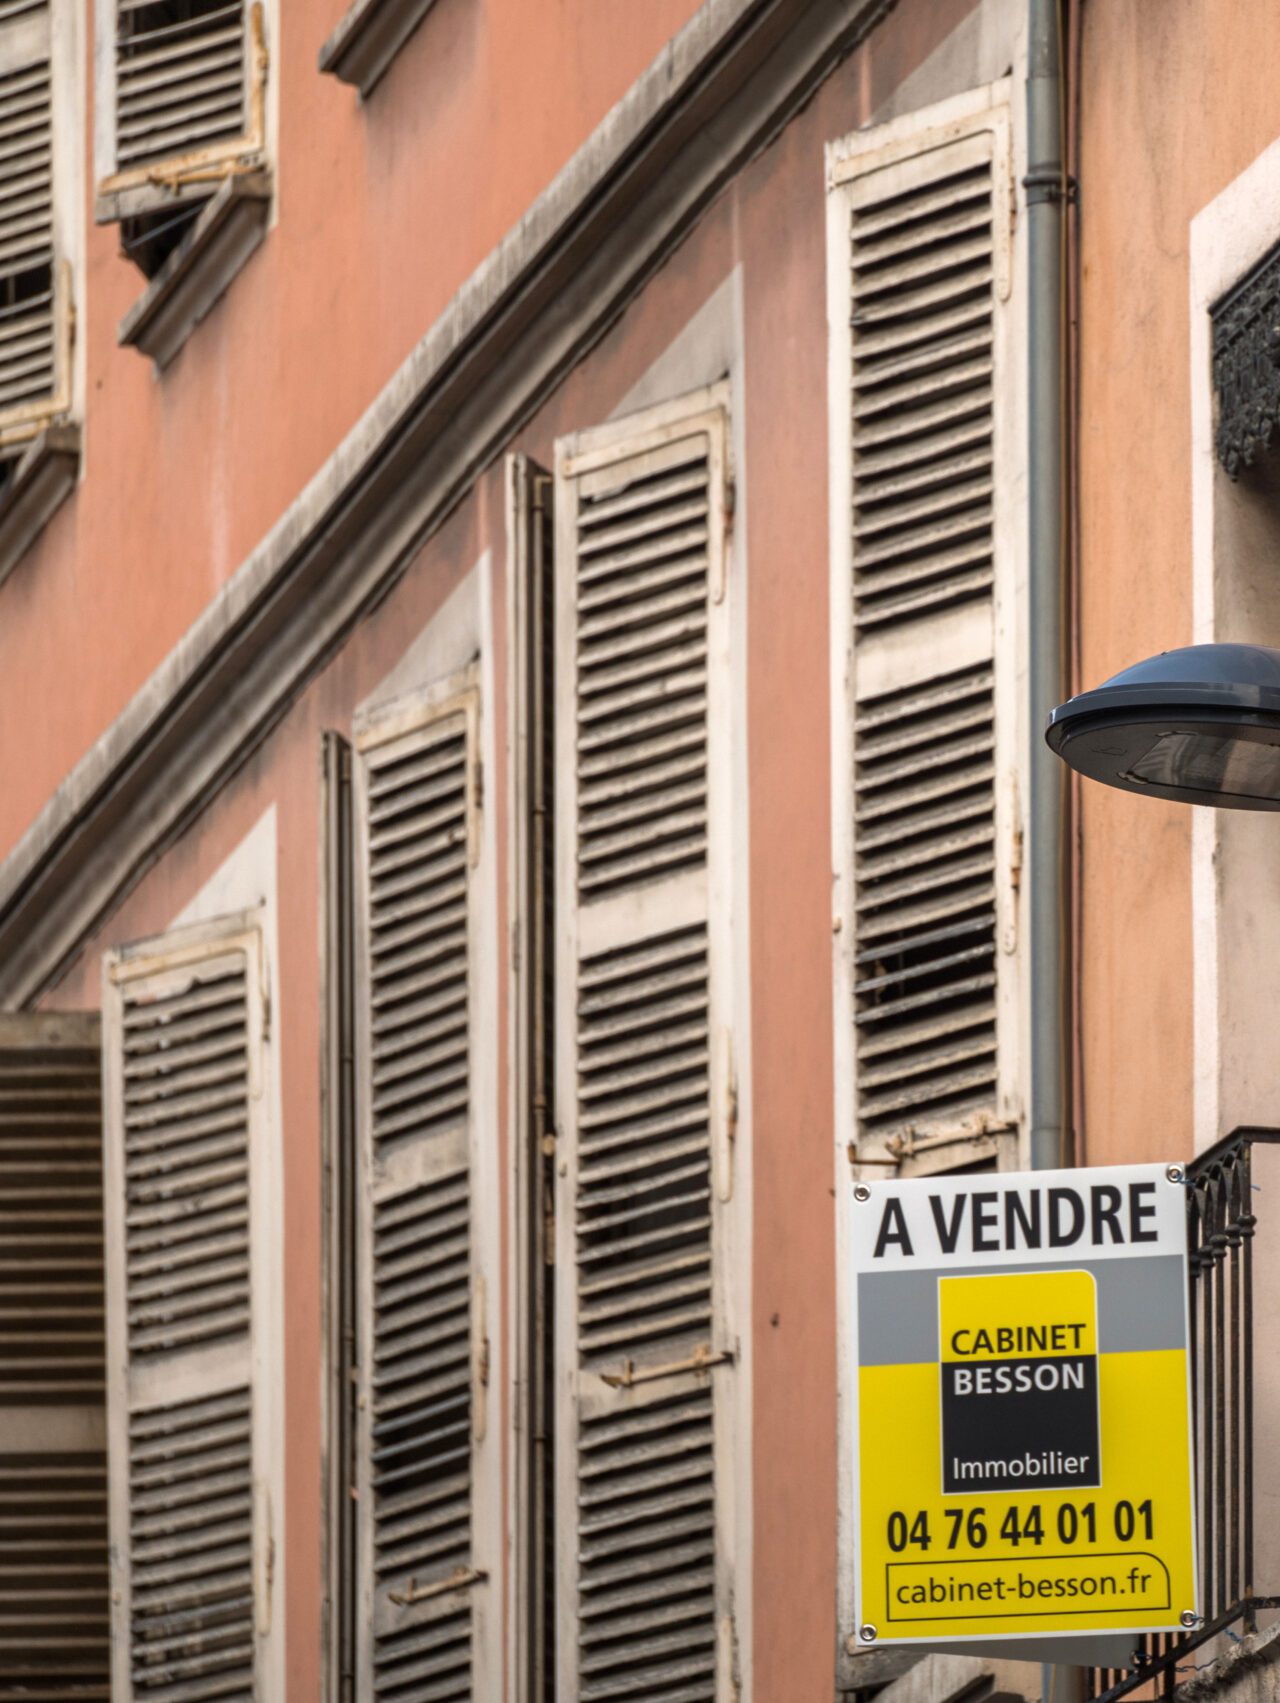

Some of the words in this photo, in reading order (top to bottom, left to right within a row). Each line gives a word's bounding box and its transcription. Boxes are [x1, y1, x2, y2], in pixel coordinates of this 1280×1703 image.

[873, 1197, 915, 1258] A
[928, 1182, 1158, 1254] VENDRE
[951, 1323, 1087, 1355] CABINET
[954, 1363, 1085, 1396] BESSON
[953, 1451, 1090, 1480] Immobilier
[887, 1510, 931, 1552] 04
[944, 1507, 987, 1550] 76
[1000, 1505, 1044, 1547] 44
[1057, 1502, 1097, 1544] 01
[1114, 1499, 1153, 1542] 01
[896, 1567, 1152, 1605] cabinet-besson.fr
